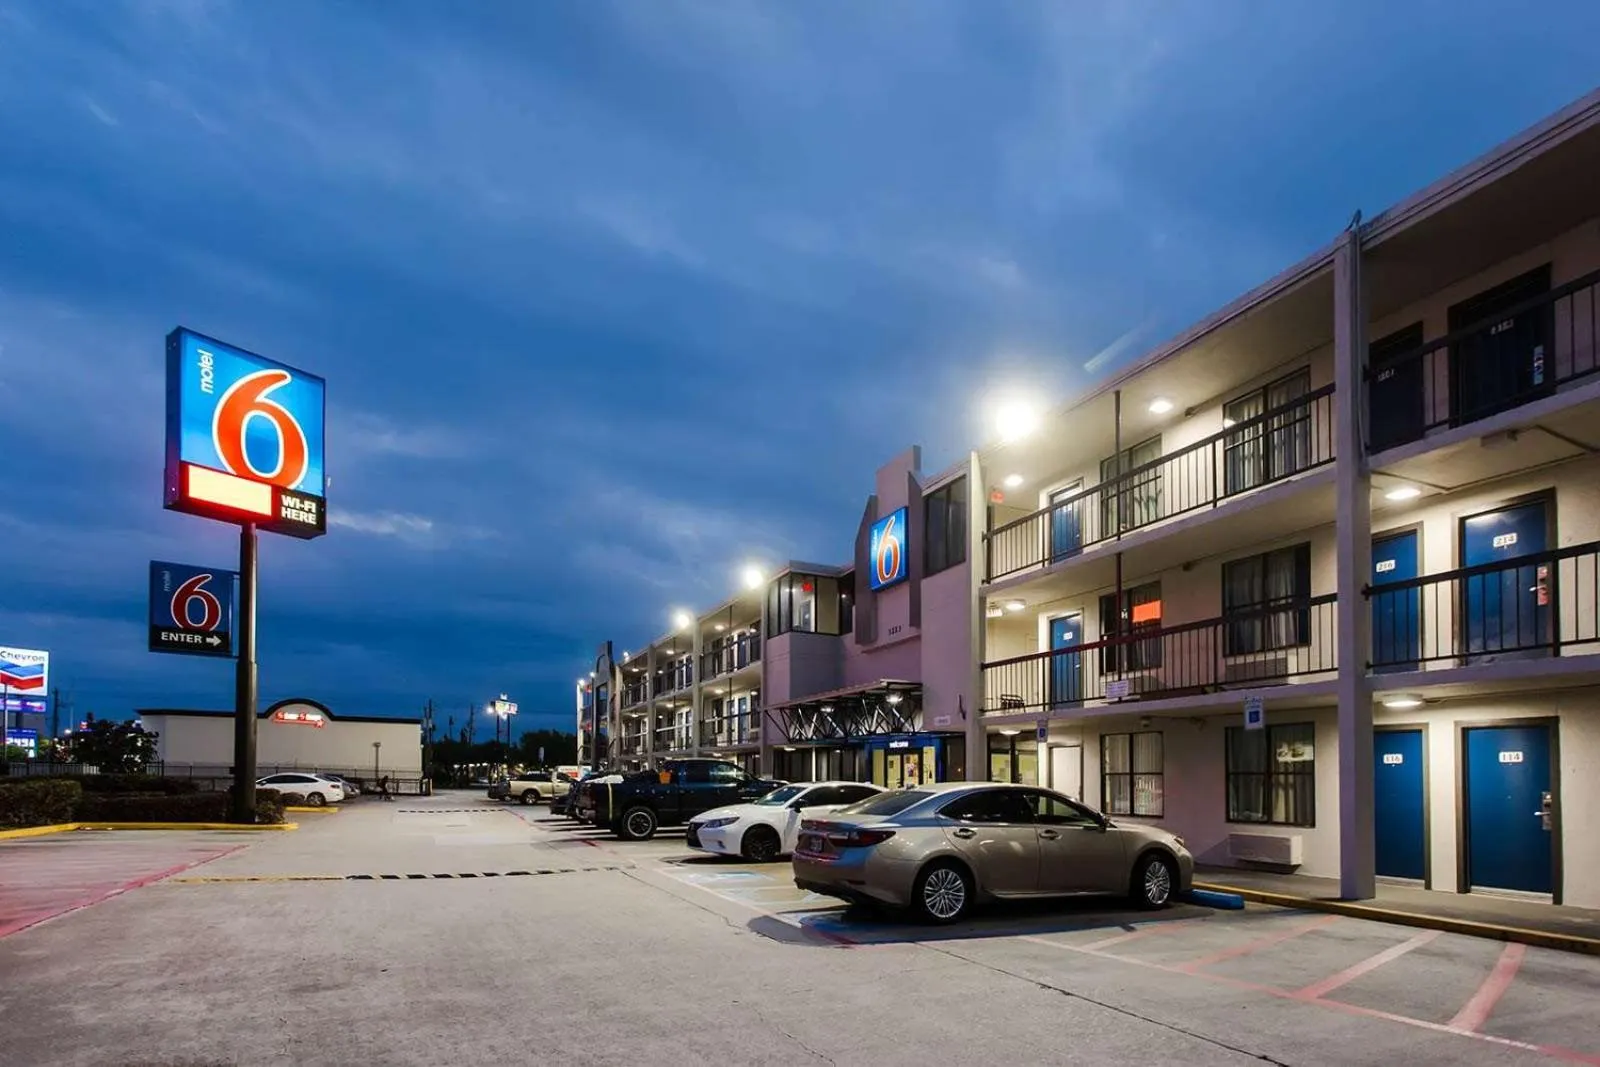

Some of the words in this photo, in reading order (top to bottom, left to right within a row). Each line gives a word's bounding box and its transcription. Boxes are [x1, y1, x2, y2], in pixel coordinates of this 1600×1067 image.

[197, 349, 214, 394] motel
[212, 369, 308, 489] 6
[281, 494, 316, 513] WI-FI
[281, 506, 316, 525] HERE
[1495, 534, 1515, 546] 214
[876, 515, 900, 585] 6
[1377, 561, 1394, 571] 216
[170, 574, 222, 631] 6
[161, 631, 202, 644] ENTER
[0, 650, 45, 662] Chevron
[1385, 755, 1401, 763] 116
[1502, 753, 1520, 762] 114
